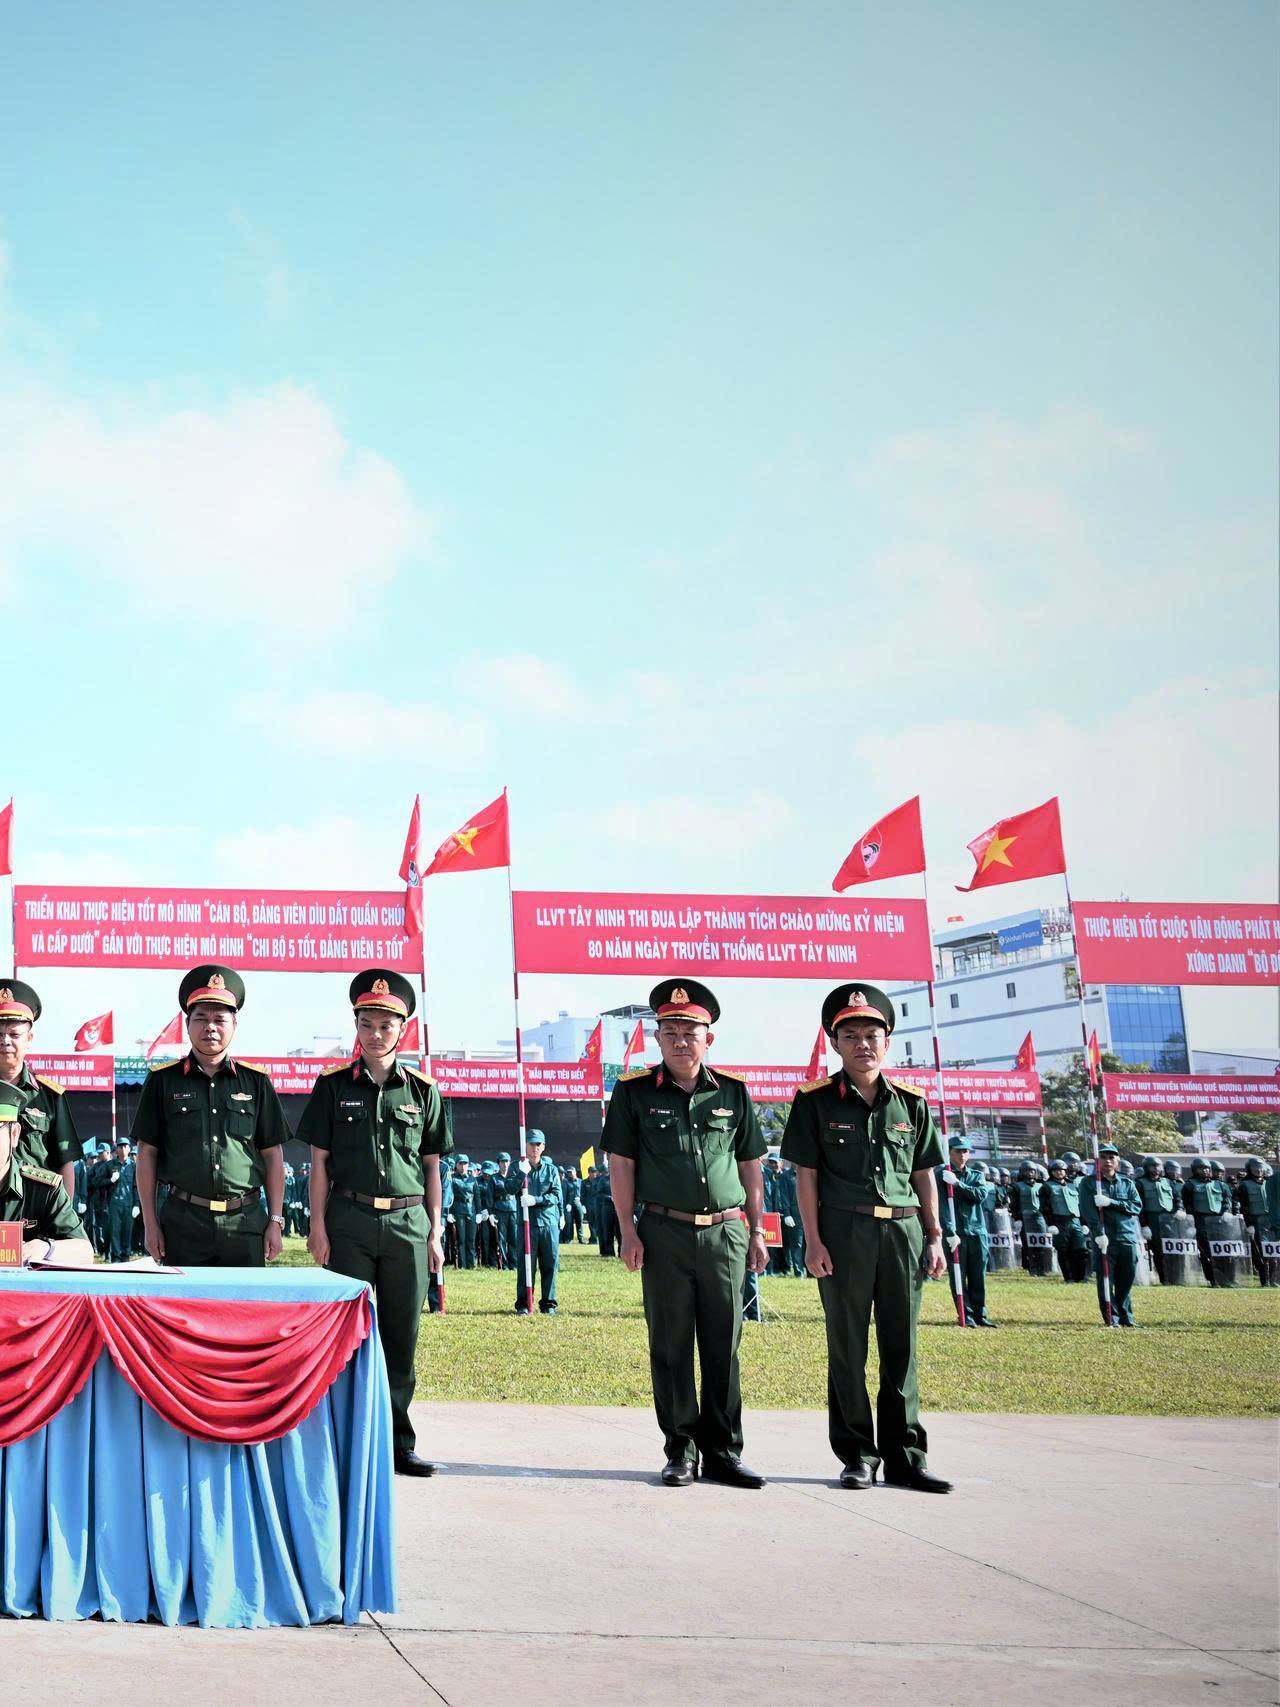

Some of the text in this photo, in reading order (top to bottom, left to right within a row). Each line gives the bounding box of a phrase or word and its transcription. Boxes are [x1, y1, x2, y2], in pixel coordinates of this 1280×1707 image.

[25, 894, 54, 920] TRIỂN
[57, 901, 80, 920] KHAI
[83, 900, 108, 925] THỰC
[111, 899, 134, 925] HIỆN
[137, 897, 155, 922] TỐT
[158, 899, 174, 922] MÔ
[177, 900, 201, 922] HÌNH
[233, 901, 250, 927] BỘ,
[252, 899, 281, 925] ĐẢNG
[283, 902, 306, 924] VIÊN
[309, 903, 325, 925] DÌU
[329, 899, 348, 925] DẮT
[381, 904, 405, 926] CHÚ
[536, 905, 905, 938] LLVT TÂY NINH THI ĐUA LẬP THÀNH TÍCH CHÀO MỪNG KỶ NIỆM
[1083, 916, 1110, 941] THỰC
[1113, 914, 1138, 942] HIỆN
[1139, 912, 1158, 938] TỐT
[1160, 915, 1188, 943] CUỘC
[1190, 915, 1212, 943] VẬN
[1214, 916, 1242, 943] ĐỘNG
[1245, 916, 1270, 940] PHÁT
[32, 930, 45, 952] VÀ
[47, 928, 68, 953] CẤP
[102, 929, 123, 954] GẮN
[126, 932, 142, 954] VỚI
[146, 934, 171, 959] THỰC
[174, 933, 198, 960] HIỆN
[200, 934, 216, 957] MÔ
[220, 935, 244, 957] HÌNH
[273, 936, 286, 961] BỘ
[289, 939, 294, 958] 5
[298, 933, 317, 960] TỐT,
[320, 934, 348, 959] ĐẢNG
[351, 936, 374, 960] VIÊN
[376, 941, 383, 960] 5
[588, 935, 857, 963] 80 NĂM NGÀY TRUYỀN THỐNG LLVT TÂY NINH
[1186, 950, 1216, 973] XỨNG
[1218, 954, 1247, 973] DANH
[0, 1249, 17, 1262] ĐUA
